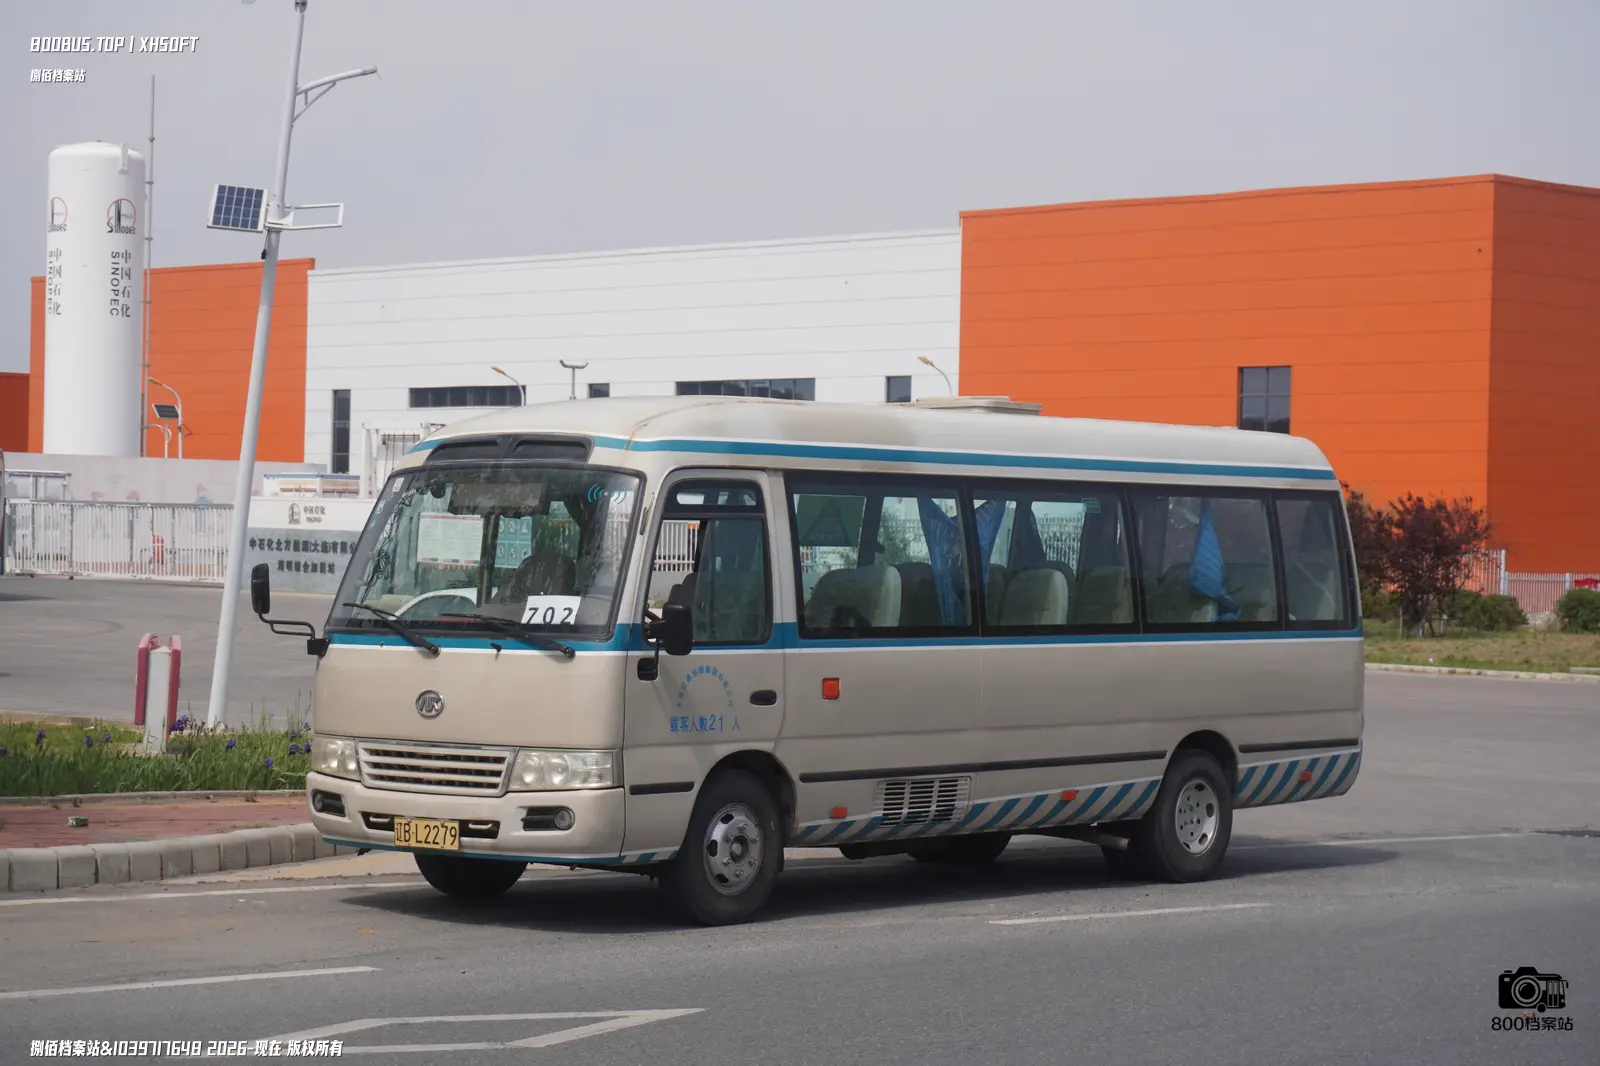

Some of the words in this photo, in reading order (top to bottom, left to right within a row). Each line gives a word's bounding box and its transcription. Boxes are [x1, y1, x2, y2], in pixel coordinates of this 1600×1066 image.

[110, 251, 120, 316] SINOPEC
[121, 249, 131, 318] 中国石化
[525, 606, 574, 625] 702
